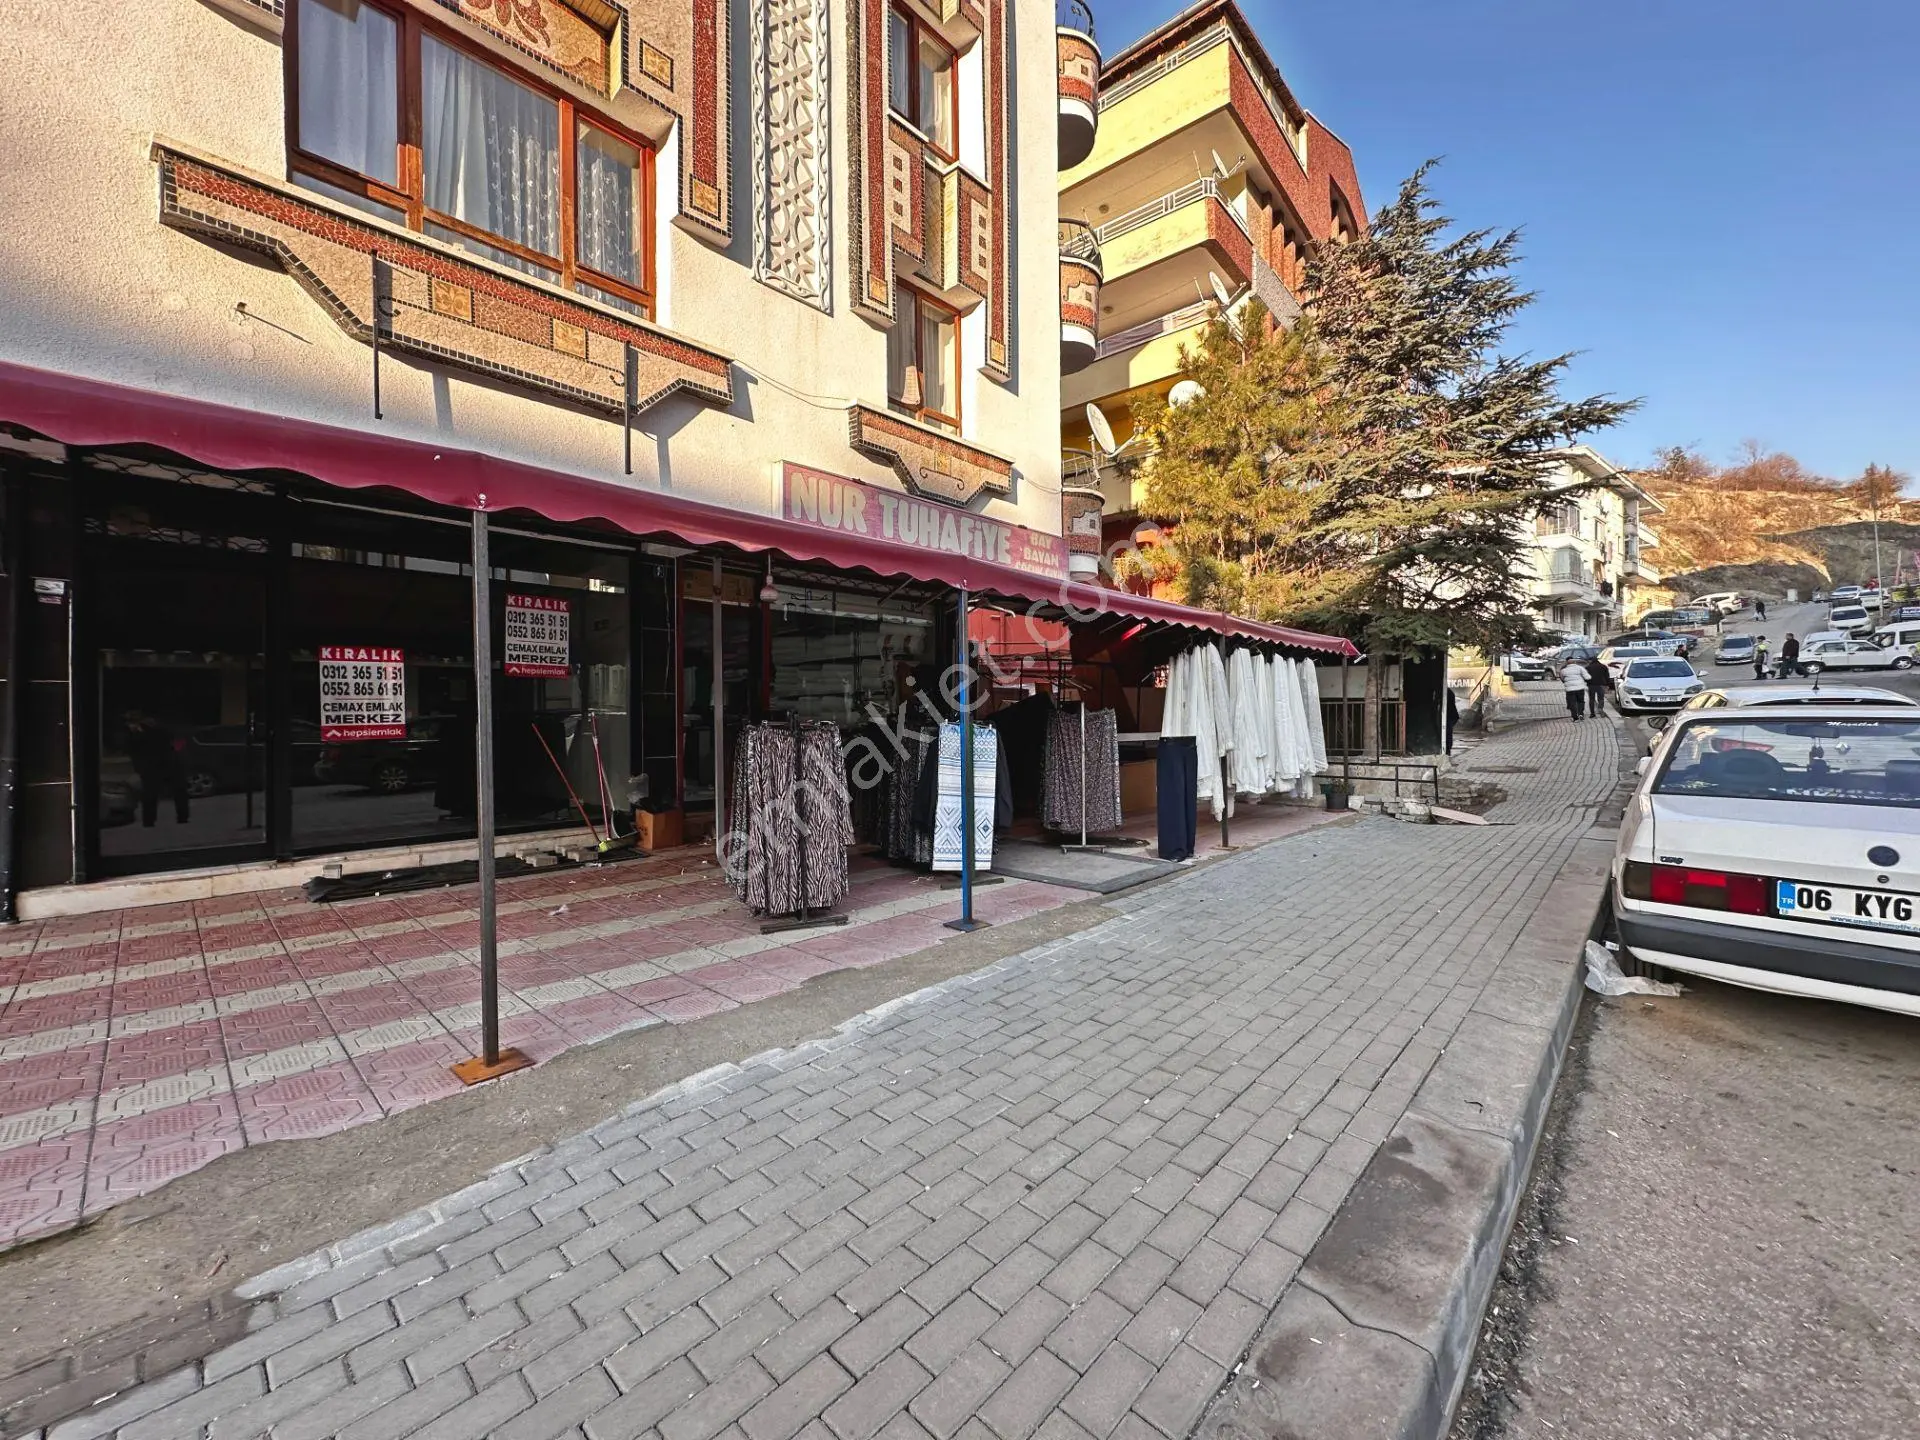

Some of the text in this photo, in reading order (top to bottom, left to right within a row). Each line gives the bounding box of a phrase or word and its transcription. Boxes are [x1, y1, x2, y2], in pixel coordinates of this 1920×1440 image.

[791, 473, 867, 533] NUR
[507, 611, 568, 628] 0312 365 51 51
[507, 625, 568, 641] 0552 865 61 51
[507, 643, 567, 655] CEMAX EMLAK
[508, 654, 567, 664] MERKEZ
[322, 665, 402, 680] 0312 365 51 51
[322, 681, 402, 696] 0552 865 61 51
[323, 702, 403, 712] CEMAX EMLAK
[325, 713, 402, 724] MERKEZ
[343, 728, 402, 737] hepsiemlak
[1781, 897, 1794, 905] TR
[1797, 887, 1912, 921] 06 KYG
